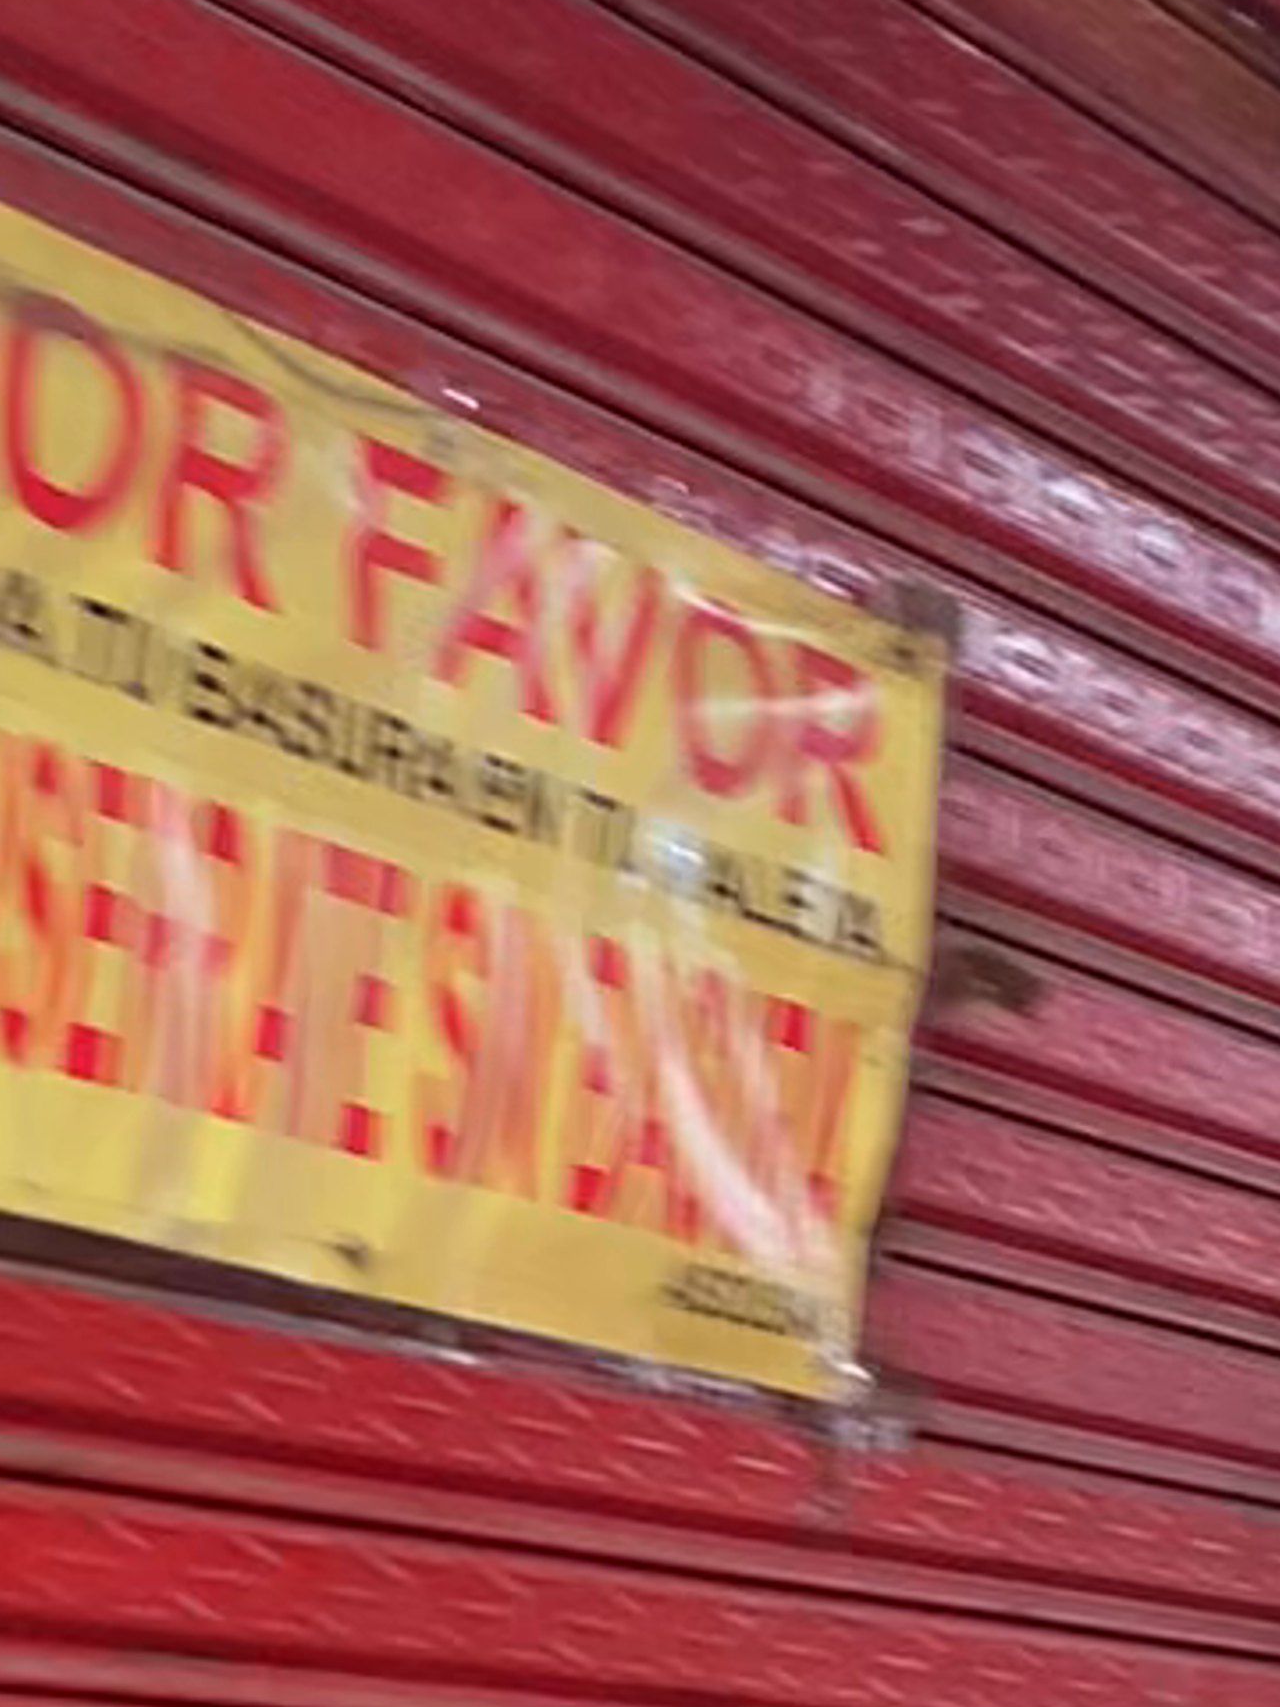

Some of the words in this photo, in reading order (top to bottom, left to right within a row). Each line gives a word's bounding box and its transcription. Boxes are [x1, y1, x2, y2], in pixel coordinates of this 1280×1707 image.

[184, 638, 462, 814] BASURA
[470, 748, 561, 848] EN
[335, 431, 892, 857] FAVOR
